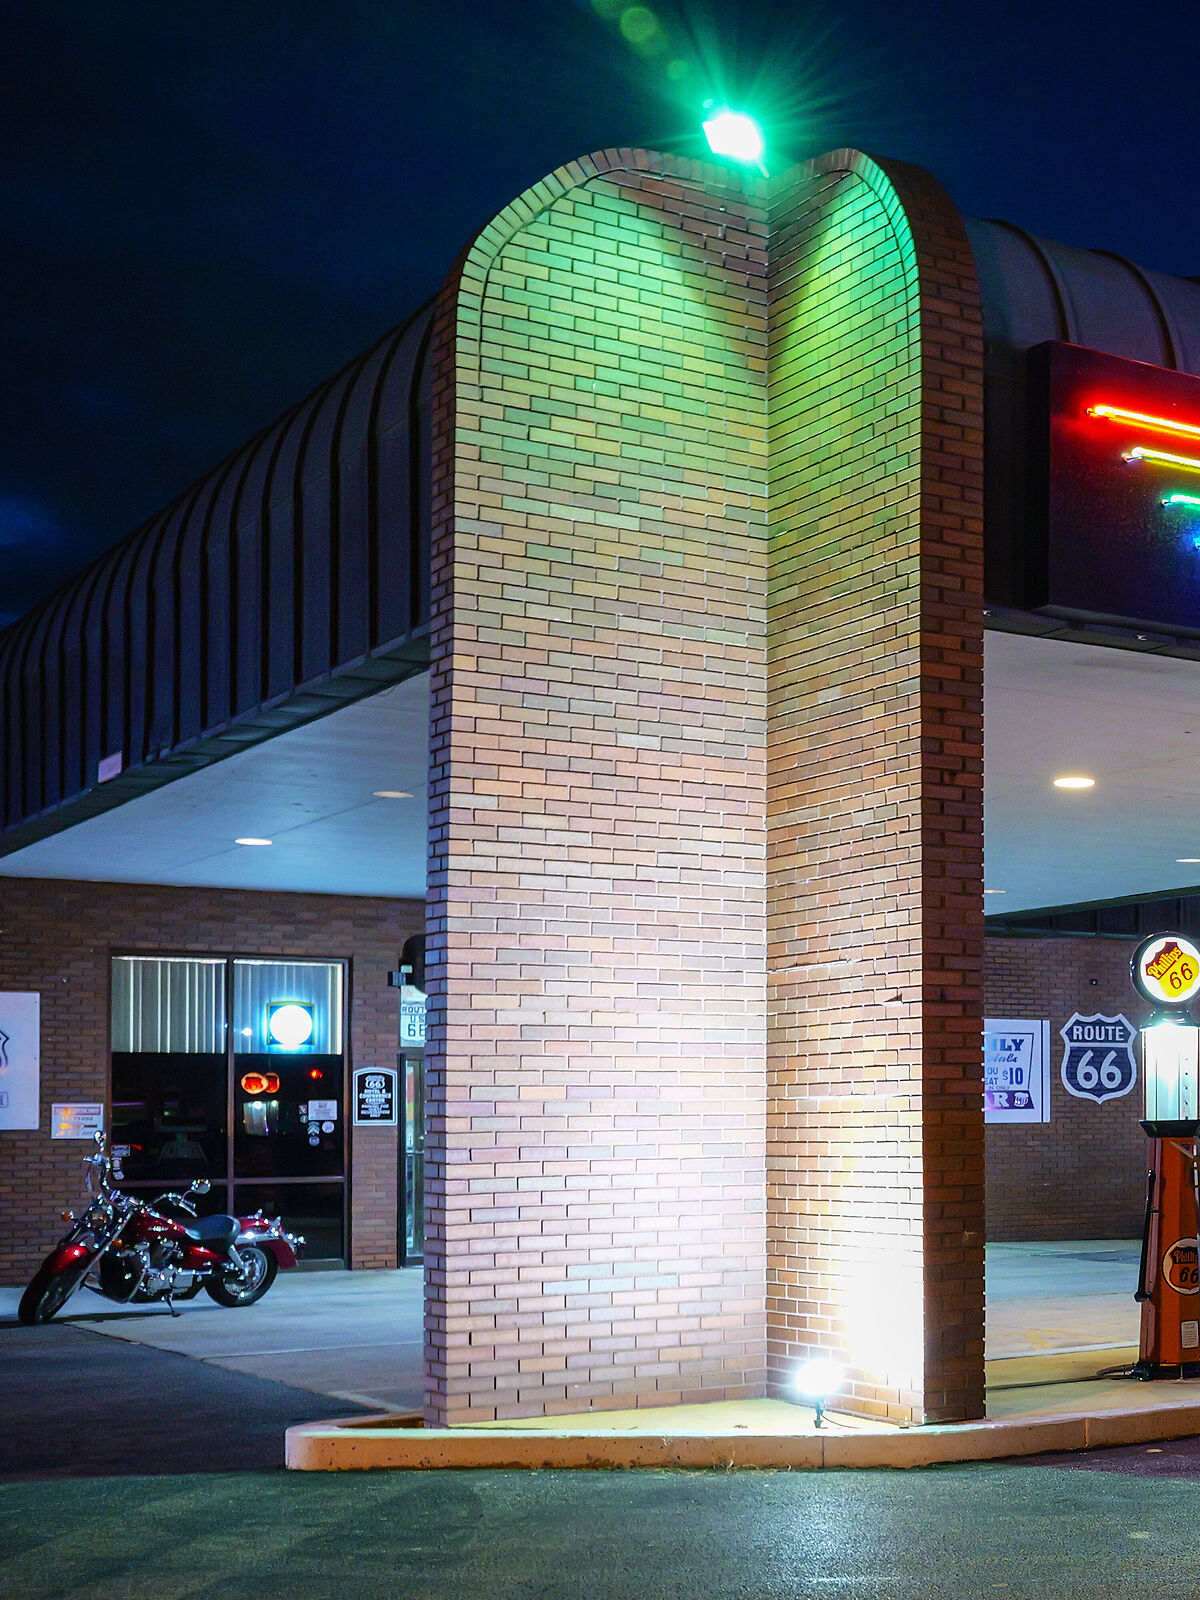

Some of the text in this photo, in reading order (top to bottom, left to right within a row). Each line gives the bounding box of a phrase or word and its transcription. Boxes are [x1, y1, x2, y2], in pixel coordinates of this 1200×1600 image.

[1147, 947, 1182, 978] Phillips
[1169, 962, 1193, 990] 66
[402, 1006, 425, 1014] ROUT
[1073, 1025, 1124, 1040] ROUTE
[987, 1067, 998, 1075] OU
[1077, 1049, 1122, 1089] 66
[1180, 1266, 1199, 1284] 66
